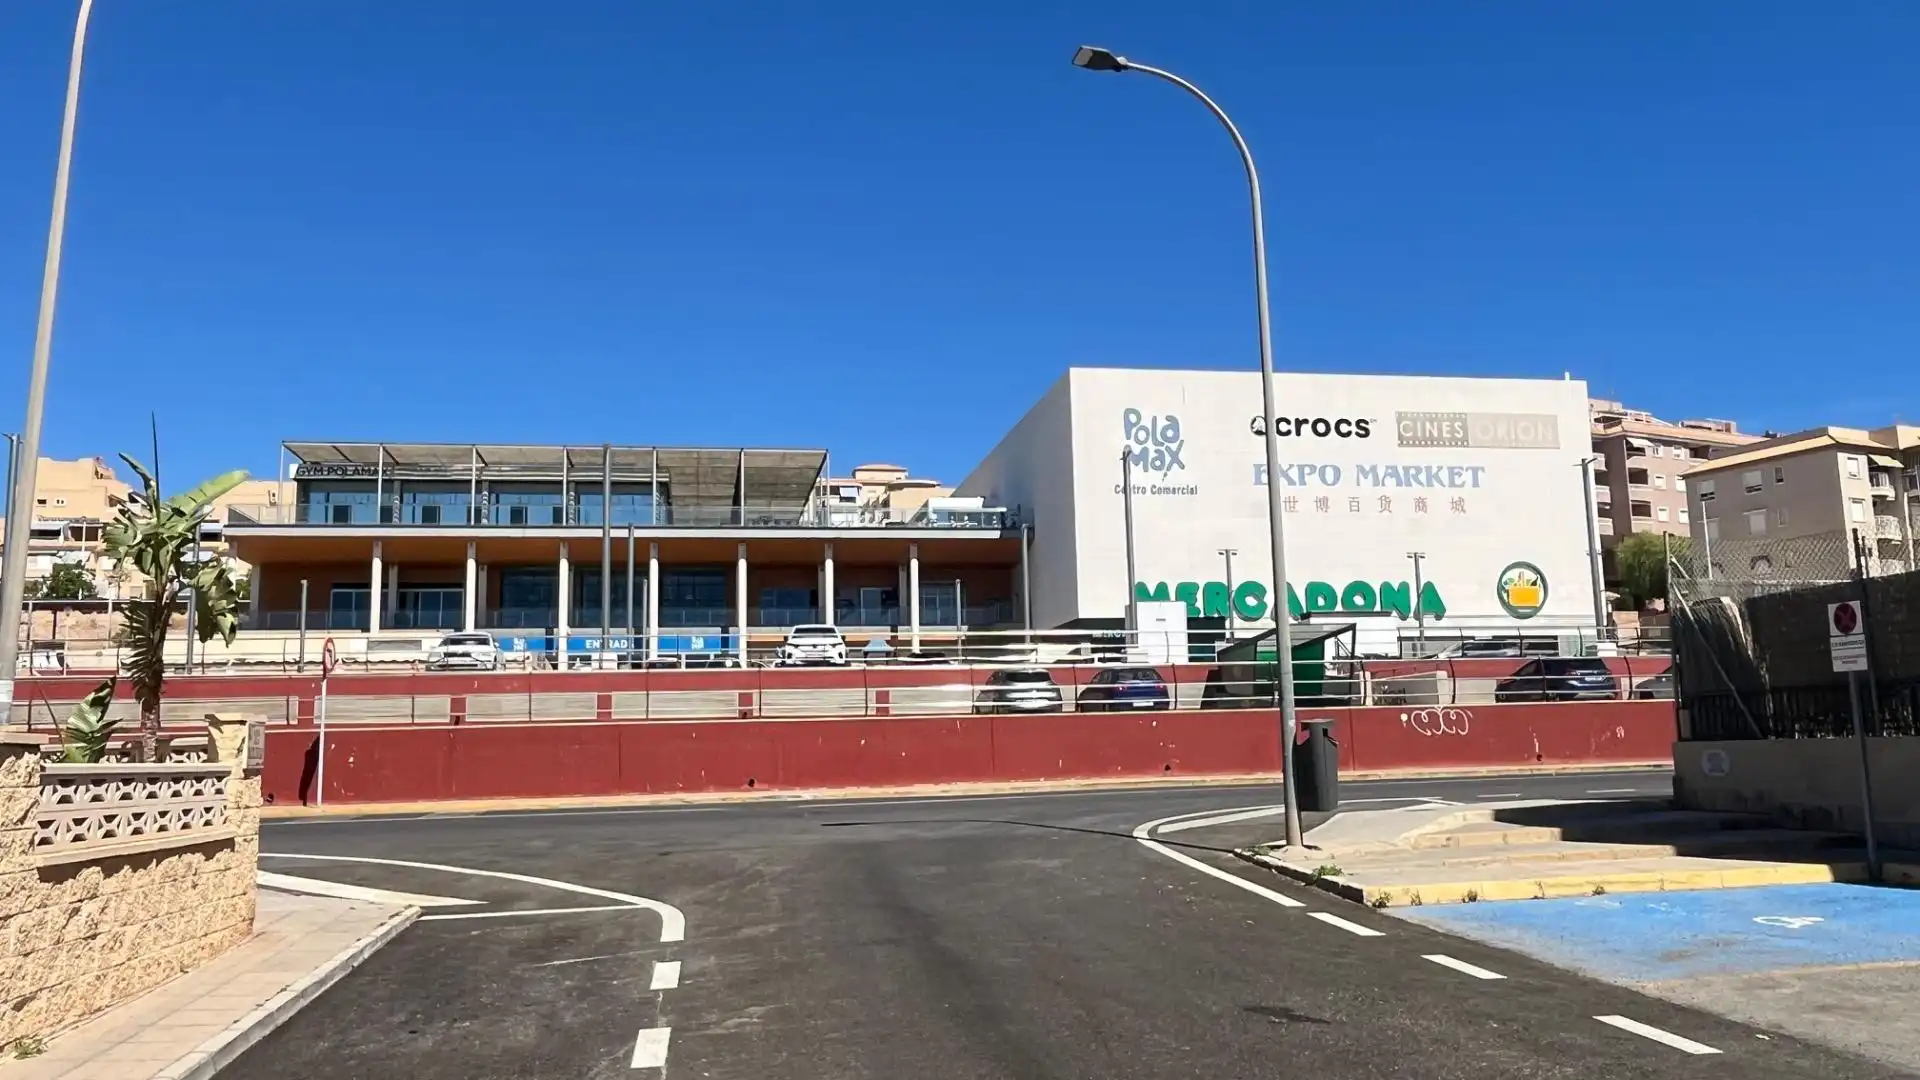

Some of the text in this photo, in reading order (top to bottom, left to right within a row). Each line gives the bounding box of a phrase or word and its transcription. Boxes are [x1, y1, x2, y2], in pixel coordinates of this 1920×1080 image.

[1275, 416, 1371, 438] crocs
[1399, 419, 1553, 441] CINES ORION
[297, 465, 323, 477] GYM
[1252, 463, 1486, 488] EXPO MARKET
[1114, 484, 1198, 496] Cetro Comercial
